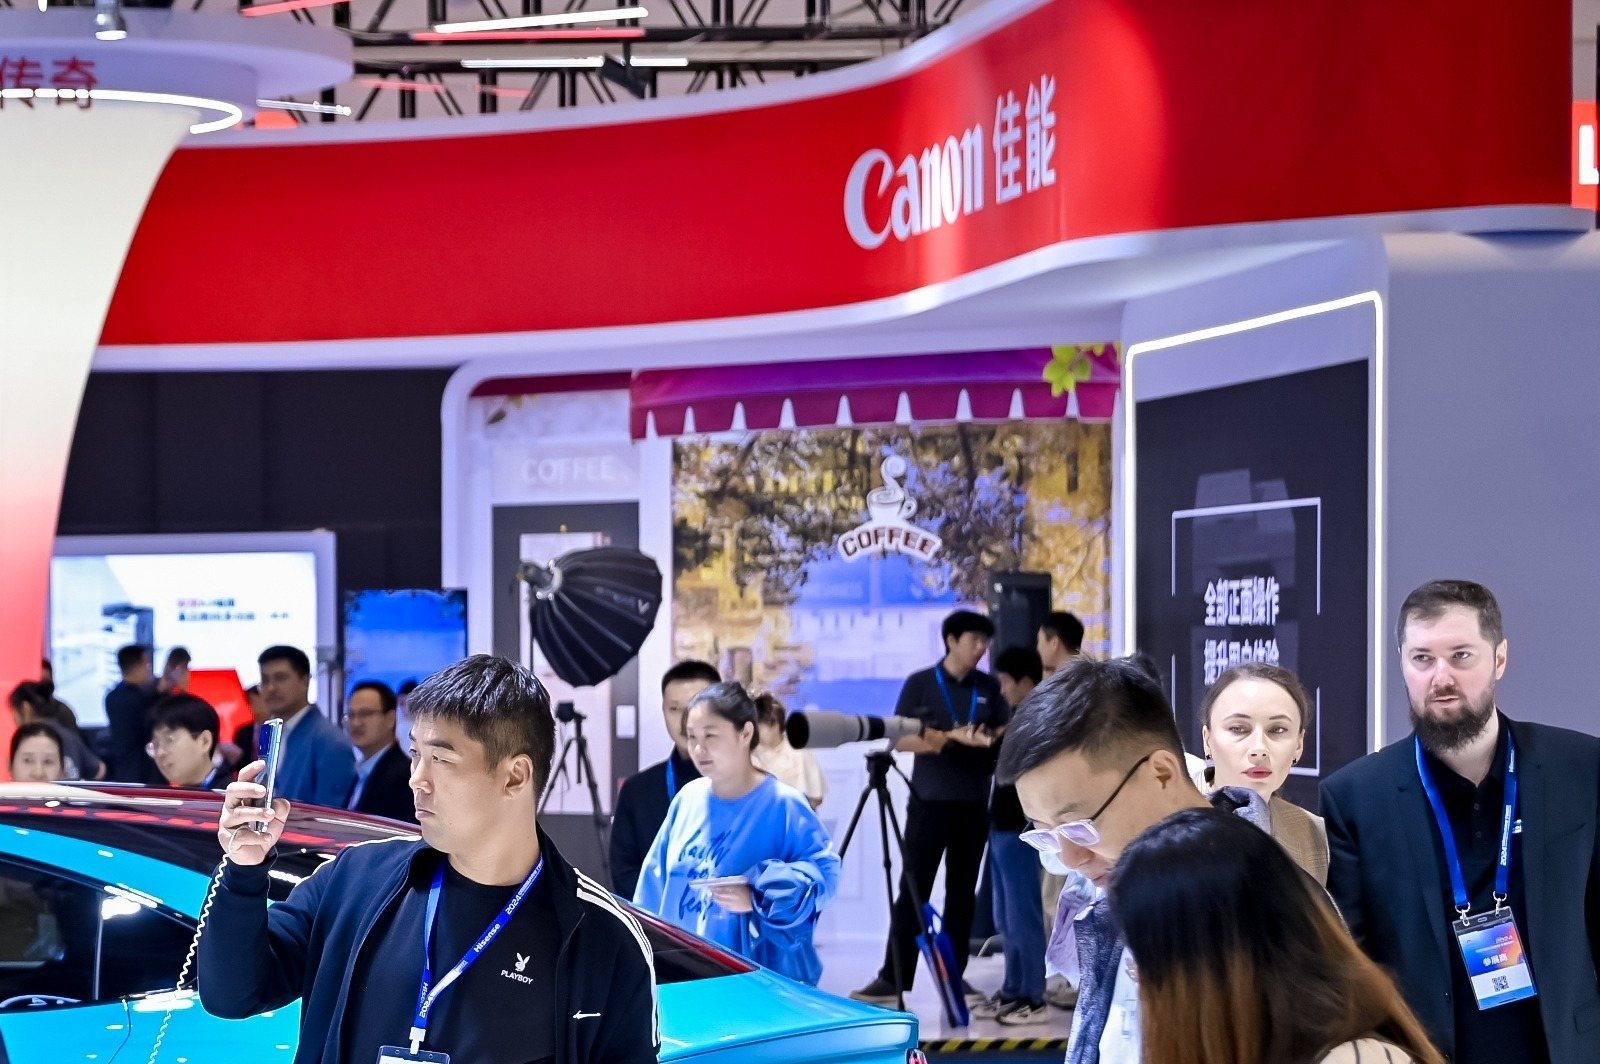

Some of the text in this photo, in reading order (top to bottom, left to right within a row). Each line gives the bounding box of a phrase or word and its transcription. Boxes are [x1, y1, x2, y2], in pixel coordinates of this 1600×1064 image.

[843, 73, 1056, 250] Canon 佳能
[843, 528, 936, 557] COFFEE
[1203, 575, 1280, 627] 全部正面操作
[505, 893, 522, 915] 2024
[473, 923, 501, 953] Hisense
[500, 969, 534, 985] PLAYBOY
